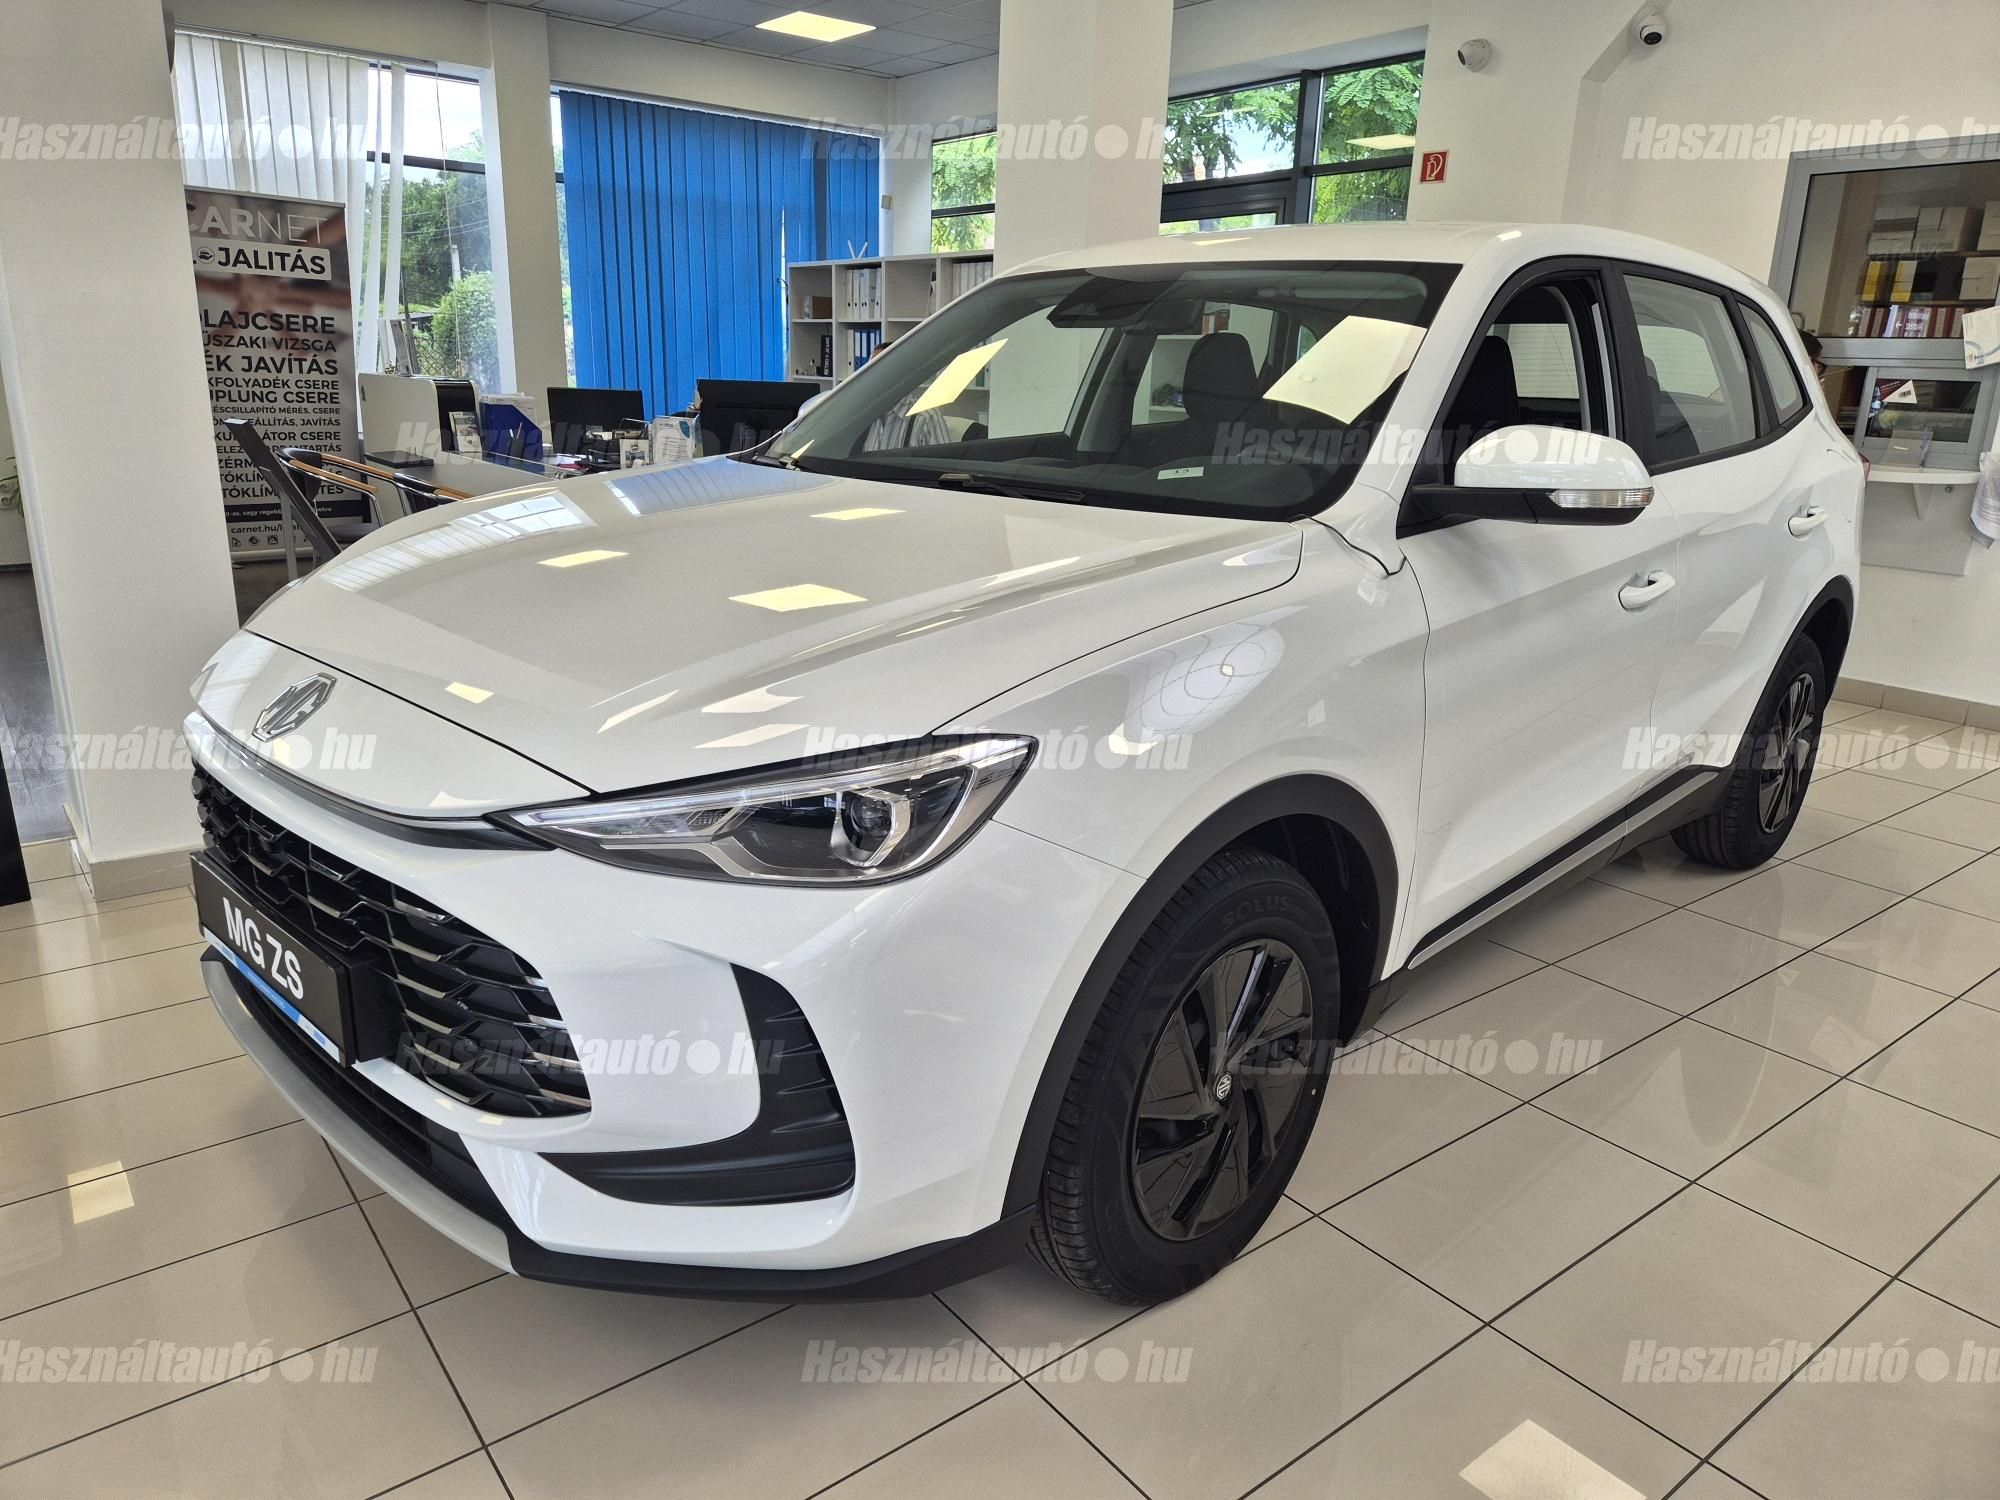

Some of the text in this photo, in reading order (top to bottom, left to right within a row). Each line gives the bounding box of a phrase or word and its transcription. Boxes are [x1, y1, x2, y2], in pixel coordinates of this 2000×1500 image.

[200, 309, 336, 334] LAJCSERE
[272, 336, 336, 352] VIZSGA
[241, 353, 338, 375] JAVÍTÁS
[295, 380, 339, 390] CSERE
[283, 391, 340, 404] CSERE
[301, 417, 340, 426] JAVÍTÁS
[300, 431, 341, 440] CSERE
[223, 897, 265, 969] MG
[266, 933, 303, 999] ZS
